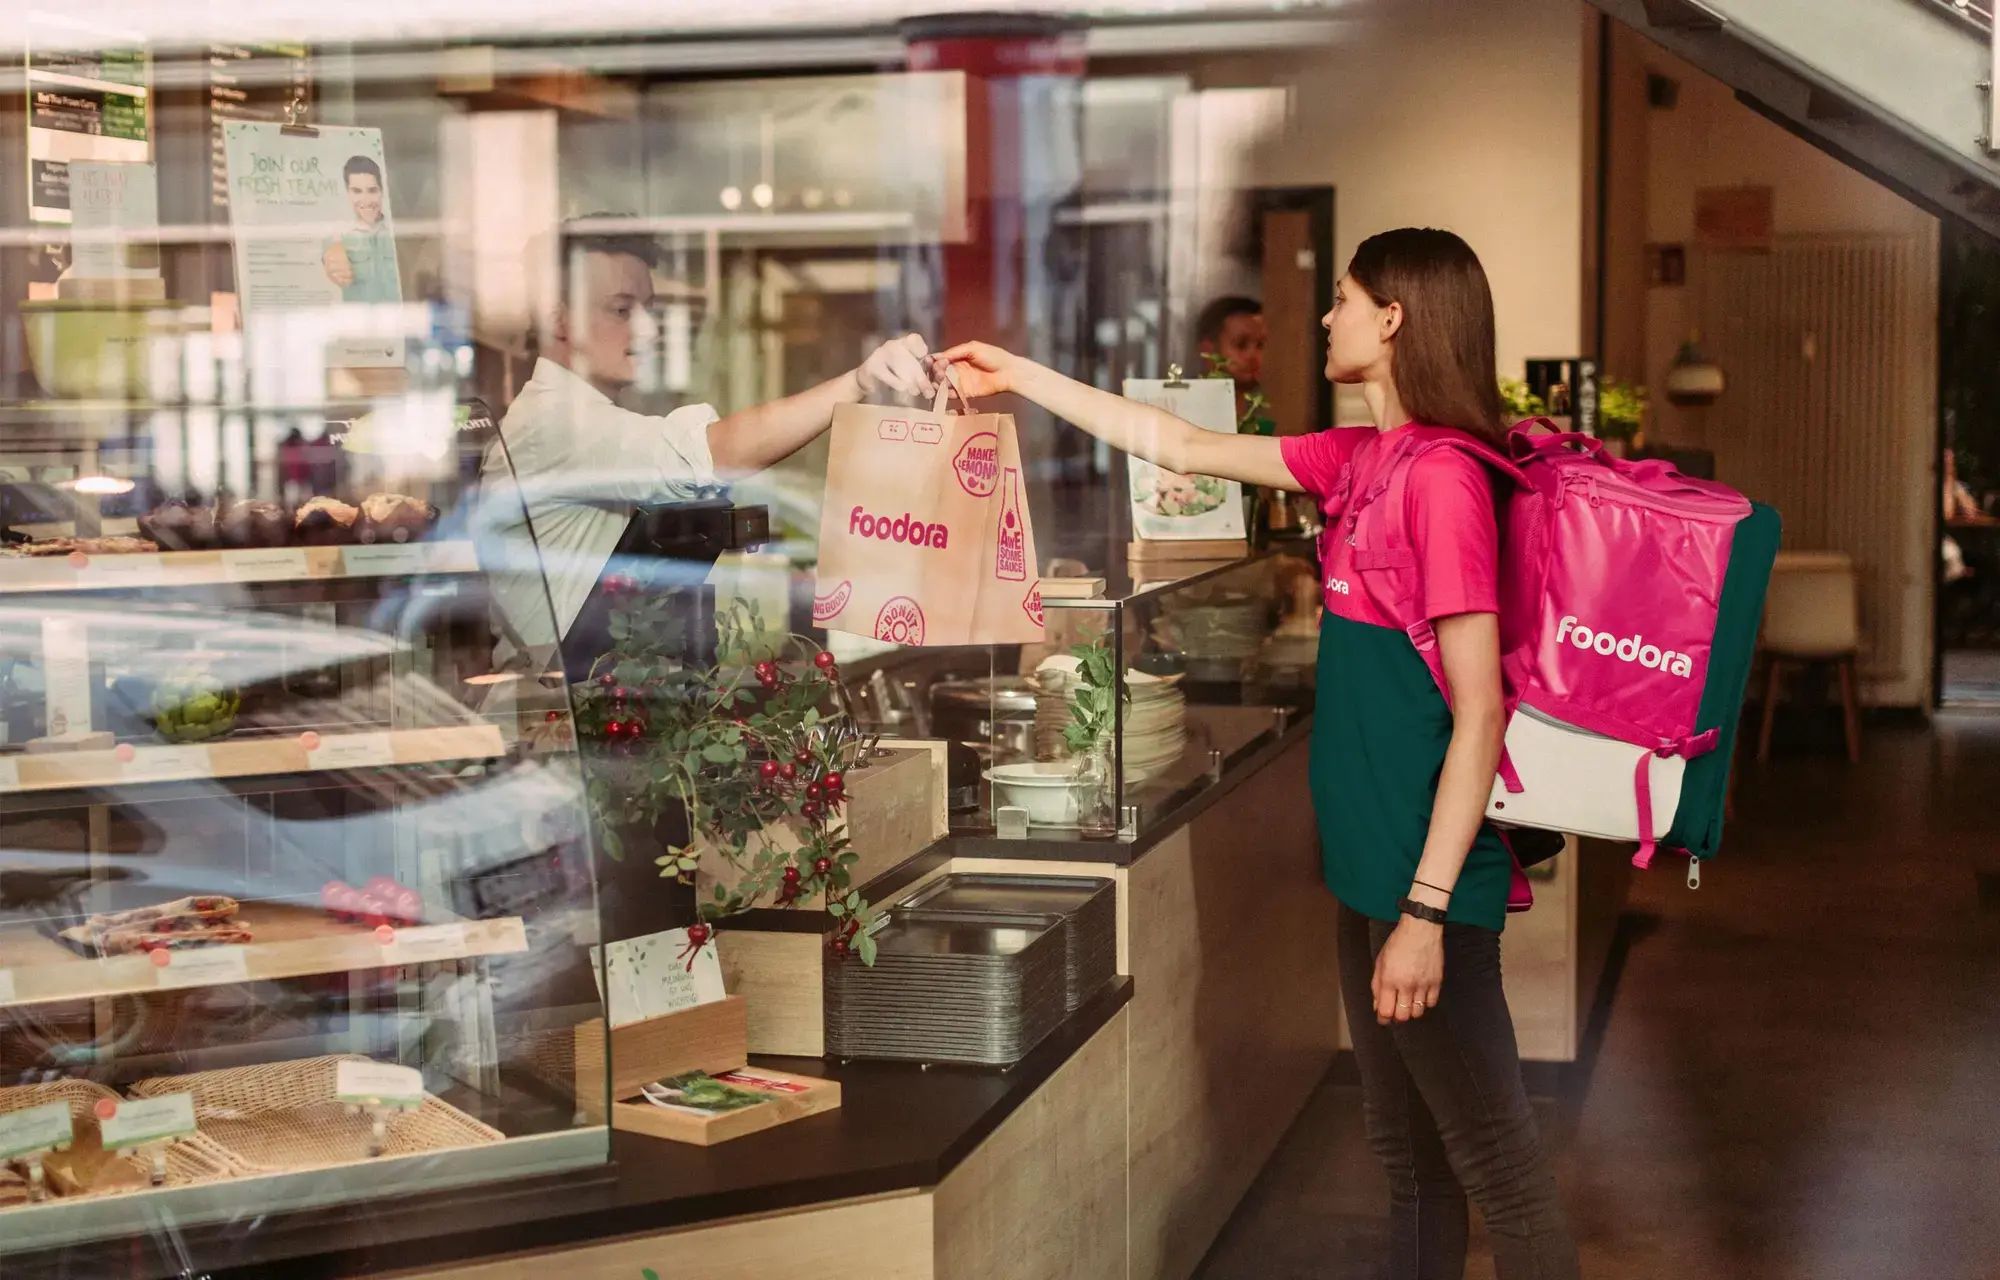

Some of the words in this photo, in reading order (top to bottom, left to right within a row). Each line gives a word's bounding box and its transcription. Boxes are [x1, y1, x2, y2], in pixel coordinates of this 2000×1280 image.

[250, 153, 284, 175] JOIN
[290, 157, 322, 176] OUR
[237, 175, 281, 196] FRESH
[967, 447, 994, 461] MAKE
[850, 506, 948, 549] foodora
[1000, 549, 1022, 561] SOME
[1000, 560, 1023, 572] SAUCE
[825, 591, 846, 613] GOOD
[884, 605, 918, 628] DONUT
[1555, 615, 1693, 678] foodora
